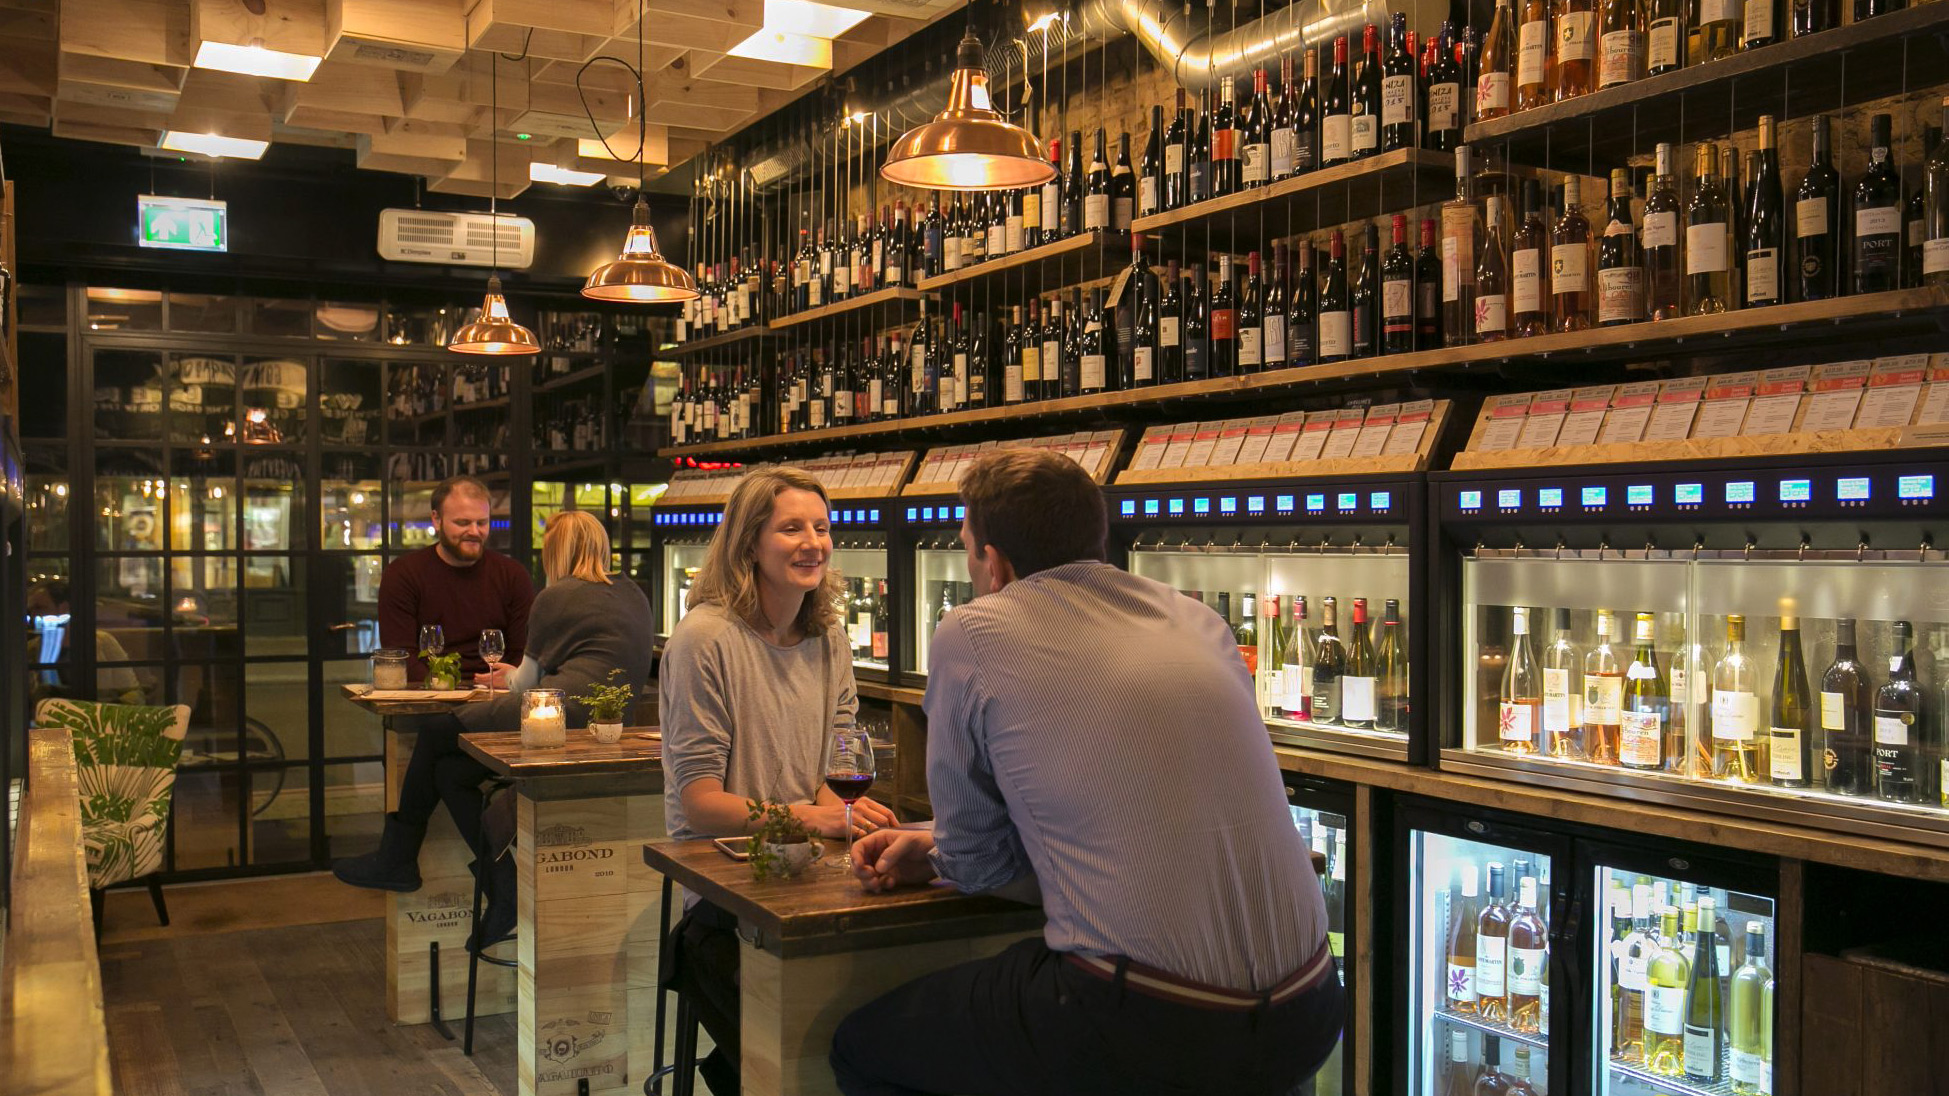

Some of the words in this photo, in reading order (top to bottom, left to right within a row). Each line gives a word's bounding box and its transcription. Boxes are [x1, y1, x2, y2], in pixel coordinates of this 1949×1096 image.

[1862, 239, 1893, 250] PORT
[1876, 747, 1899, 758] PORT
[545, 865, 574, 873] LONDON
[405, 908, 475, 923] VAGABON
